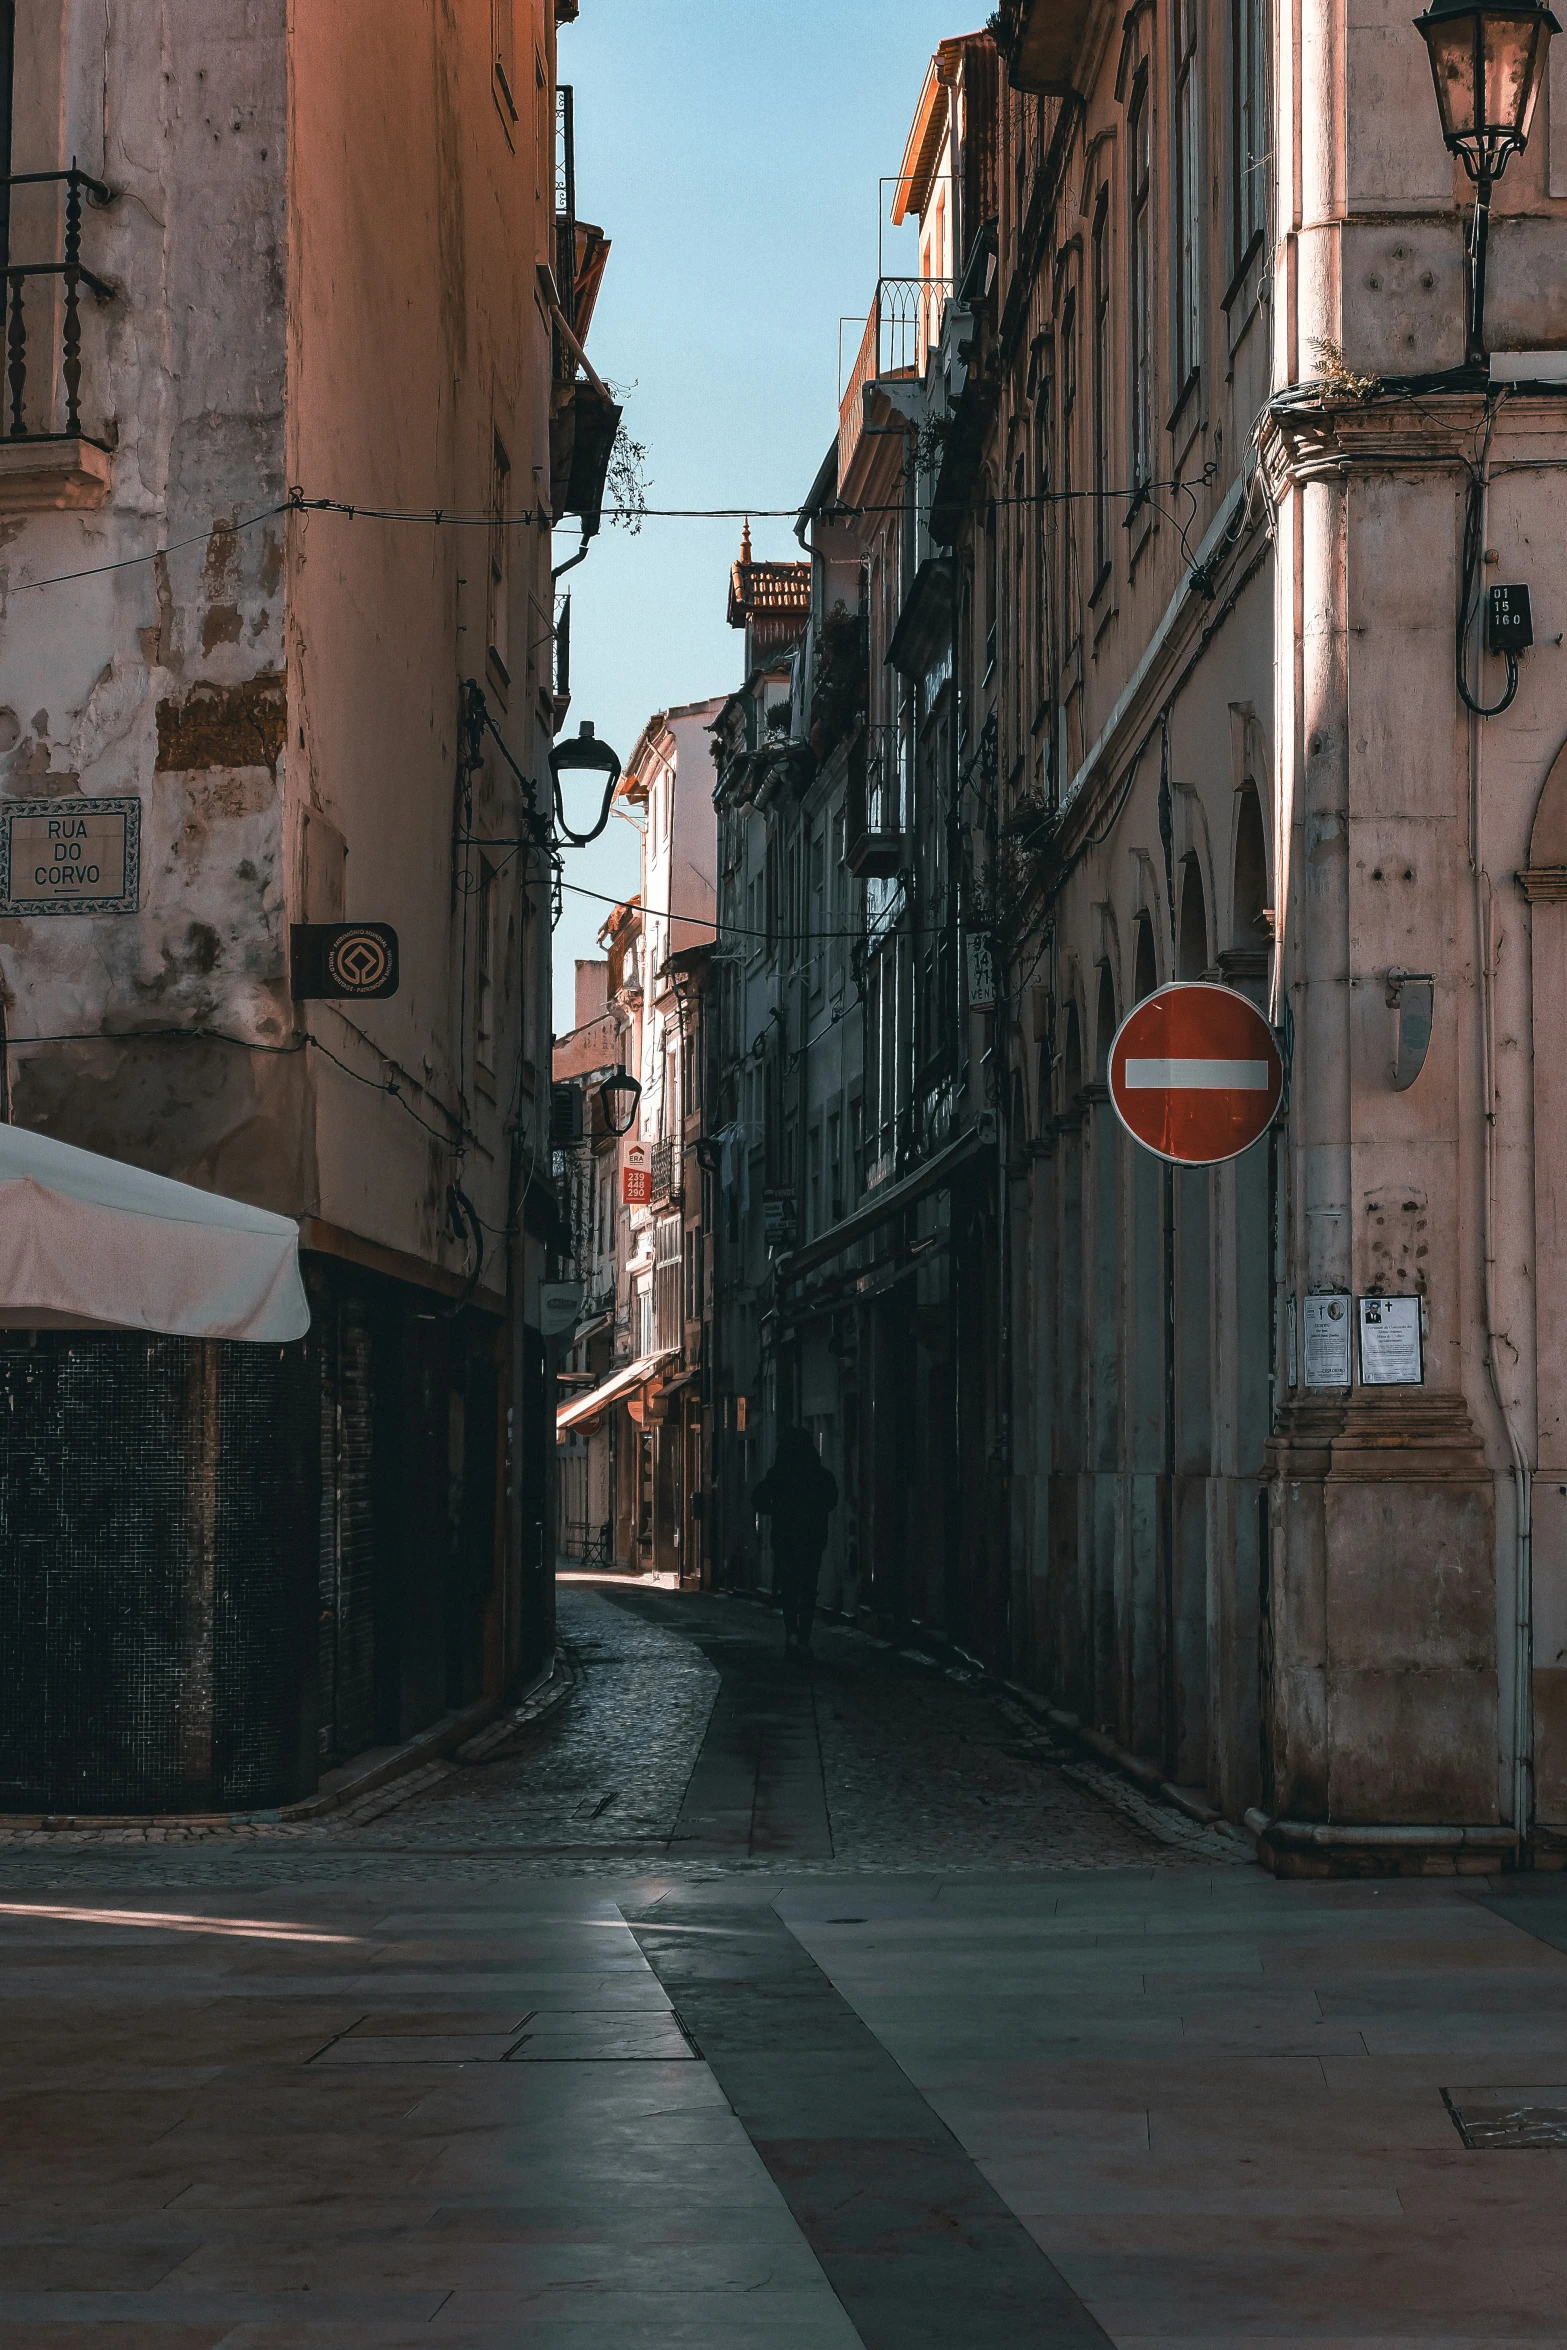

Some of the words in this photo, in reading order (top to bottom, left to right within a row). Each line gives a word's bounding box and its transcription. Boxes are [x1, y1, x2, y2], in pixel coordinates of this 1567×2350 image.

[1494, 588, 1508, 599] 01
[1494, 601, 1510, 612] 15
[1495, 614, 1521, 625] 160
[48, 820, 88, 839] RUA
[54, 842, 82, 862] DO
[34, 865, 100, 885] CORVO
[365, 930, 388, 948] MUNDIAL
[328, 951, 336, 972] WORLD
[331, 972, 354, 992] HERITAGE
[628, 1173, 645, 1181] 239
[627, 1181, 645, 1189] 448
[628, 1189, 645, 1197] 290
[774, 1187, 796, 1197] VENDE
